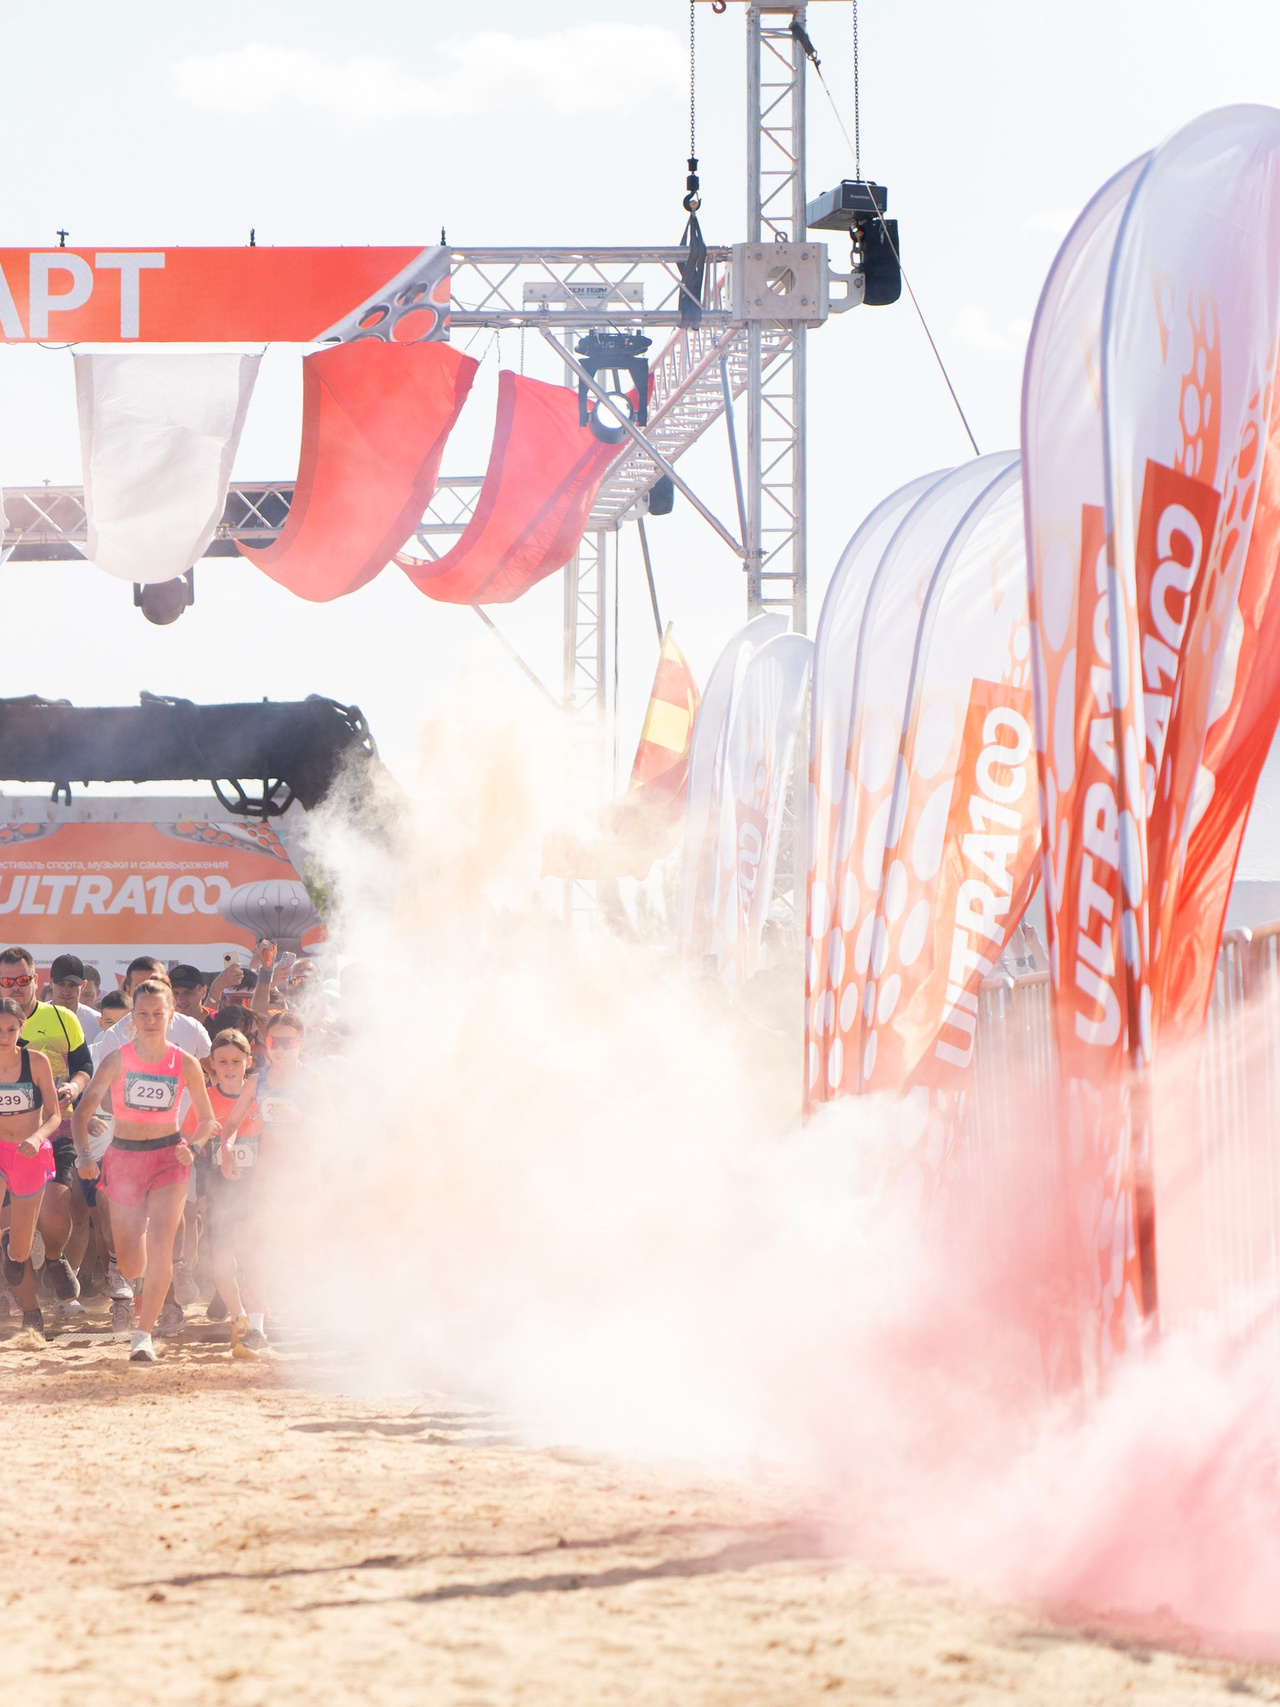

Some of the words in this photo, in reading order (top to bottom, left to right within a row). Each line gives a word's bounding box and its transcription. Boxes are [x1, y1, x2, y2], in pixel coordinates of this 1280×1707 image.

[46, 861, 86, 872] спорта,
[87, 861, 129, 871] музыки
[130, 861, 138, 870] и
[139, 861, 229, 871] самовыражения
[934, 706, 1032, 1069] ULTRA100
[137, 1086, 164, 1100] 229
